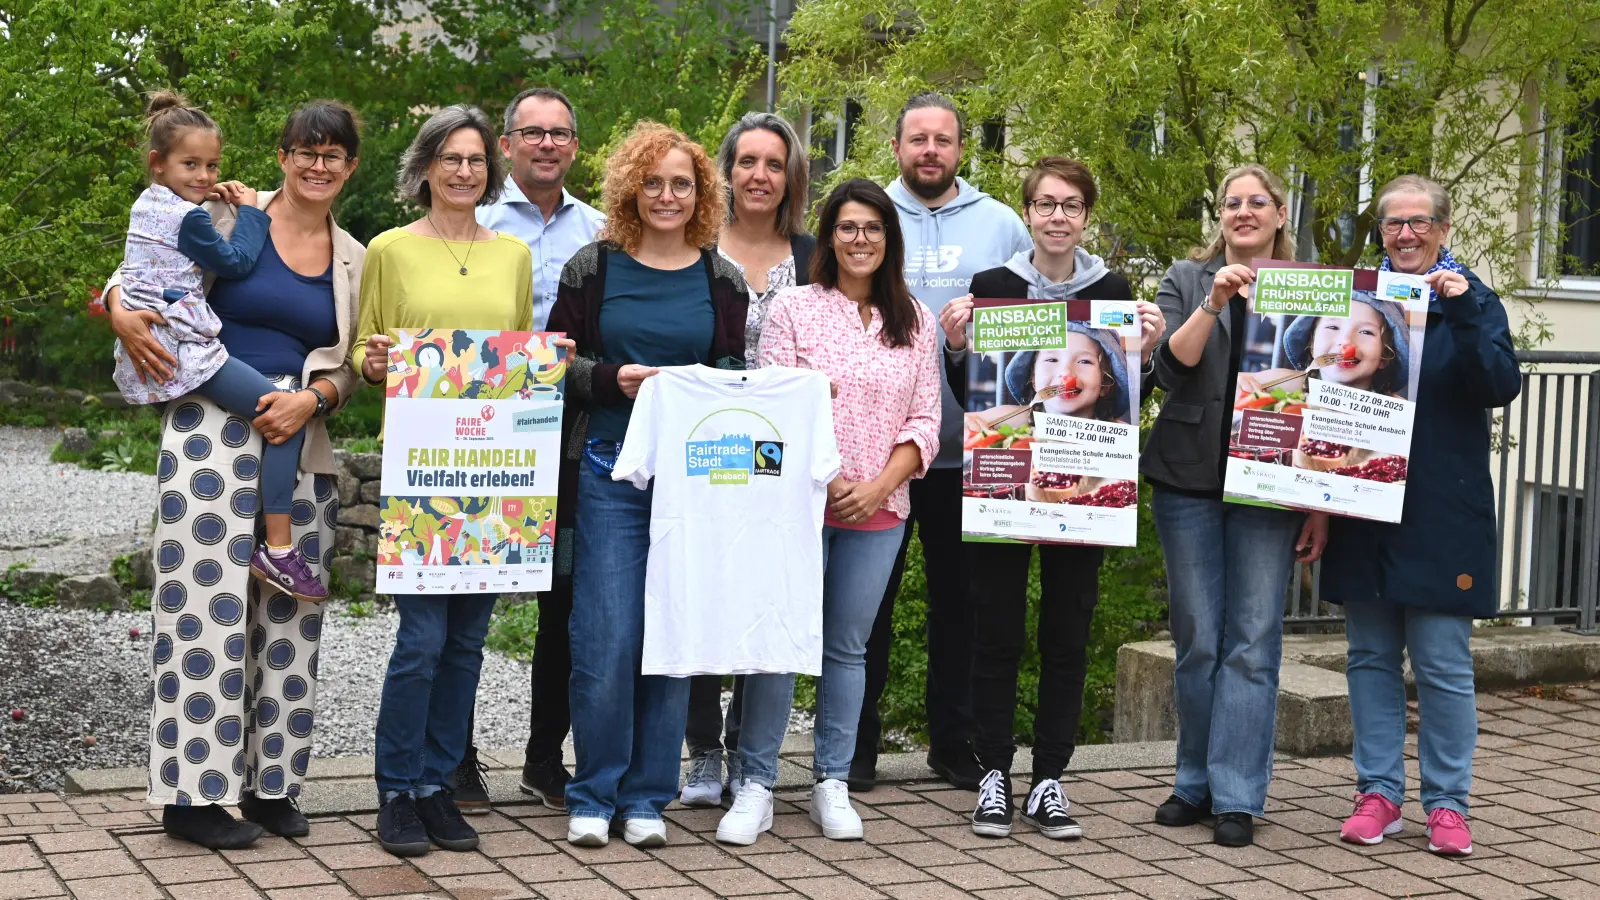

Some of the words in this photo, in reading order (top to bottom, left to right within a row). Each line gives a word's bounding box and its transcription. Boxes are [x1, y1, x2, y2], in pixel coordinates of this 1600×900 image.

[1262, 272, 1346, 288] ANSBACH
[1262, 288, 1346, 302] FRÜHSTÜCKT
[1260, 301, 1346, 313] REGIONAL&FAIR
[978, 308, 1061, 325] ANSBACH
[979, 324, 1062, 338] FRÜHSTÜCKT
[979, 336, 1063, 349] REGIONAL&FAIR
[1321, 384, 1358, 401] SAMSTAG
[1360, 394, 1404, 412] 27.09.2025
[1319, 394, 1341, 407] 10.00
[1349, 402, 1371, 414] 12.00
[1373, 407, 1391, 419] UHR
[455, 417, 482, 426] FAIRE
[516, 415, 559, 426] #fairhandeln
[1046, 416, 1083, 430] SAMSTAG
[1084, 422, 1128, 437] 27.09.2025
[1311, 413, 1353, 427] Evangelische
[1354, 421, 1377, 431] Schule
[1378, 425, 1406, 436] Ansbach
[455, 427, 487, 436] WOCHE
[1045, 427, 1067, 438] 10.00
[1075, 431, 1097, 442] 12.00
[1098, 435, 1116, 445] UHR
[1310, 422, 1353, 435] Hospitalstraße
[1354, 429, 1363, 437] 34
[688, 443, 751, 456] Fairtrade-
[1039, 446, 1081, 457] Evangelische
[1082, 450, 1104, 458] Schule
[1105, 451, 1133, 460] Ansbach
[407, 447, 450, 467] FAIR
[453, 448, 537, 468] HANDELN
[688, 456, 722, 468] Stadt
[1039, 454, 1082, 464] Hospitalstraße
[406, 469, 467, 487] Vielfalt
[470, 470, 535, 487] erleben!
[711, 471, 747, 480] Ansbach
